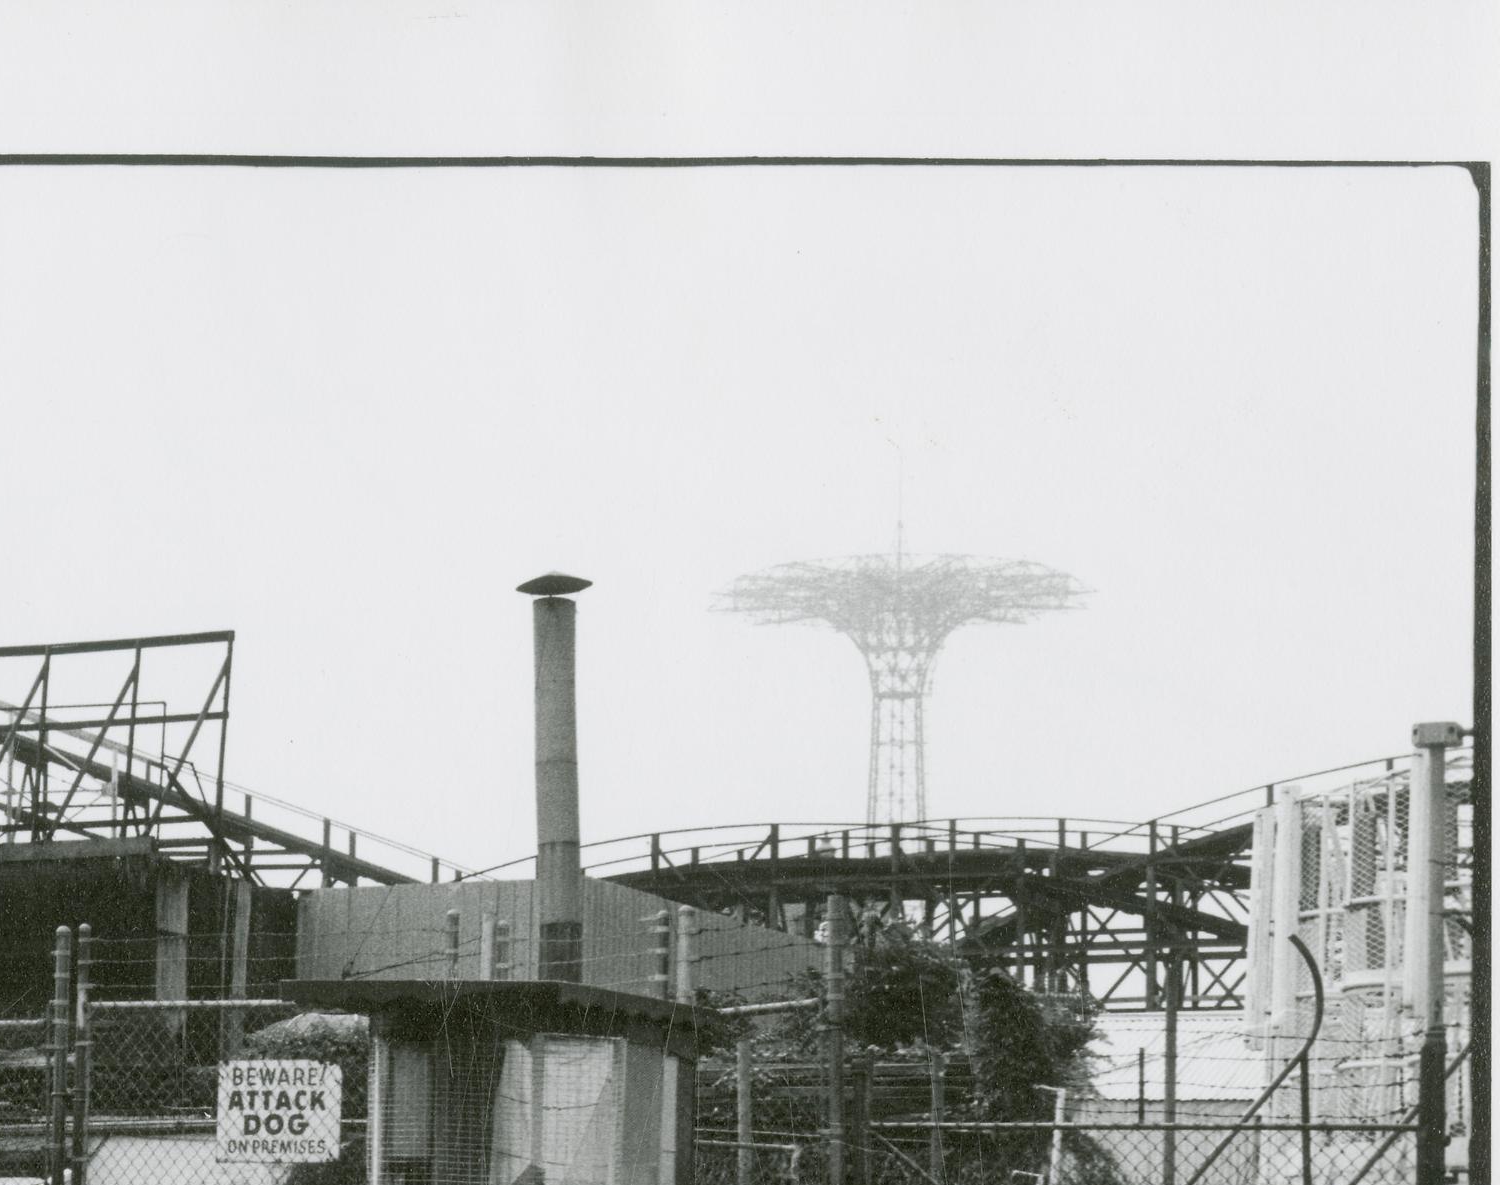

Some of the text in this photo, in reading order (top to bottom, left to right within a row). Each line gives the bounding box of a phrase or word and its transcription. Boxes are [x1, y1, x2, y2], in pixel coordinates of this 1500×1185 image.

[232, 1063, 328, 1087] BEWARE!
[228, 1090, 326, 1111] ATTACK
[243, 1113, 310, 1136] DOG
[228, 1139, 326, 1155] ON PREMISES
